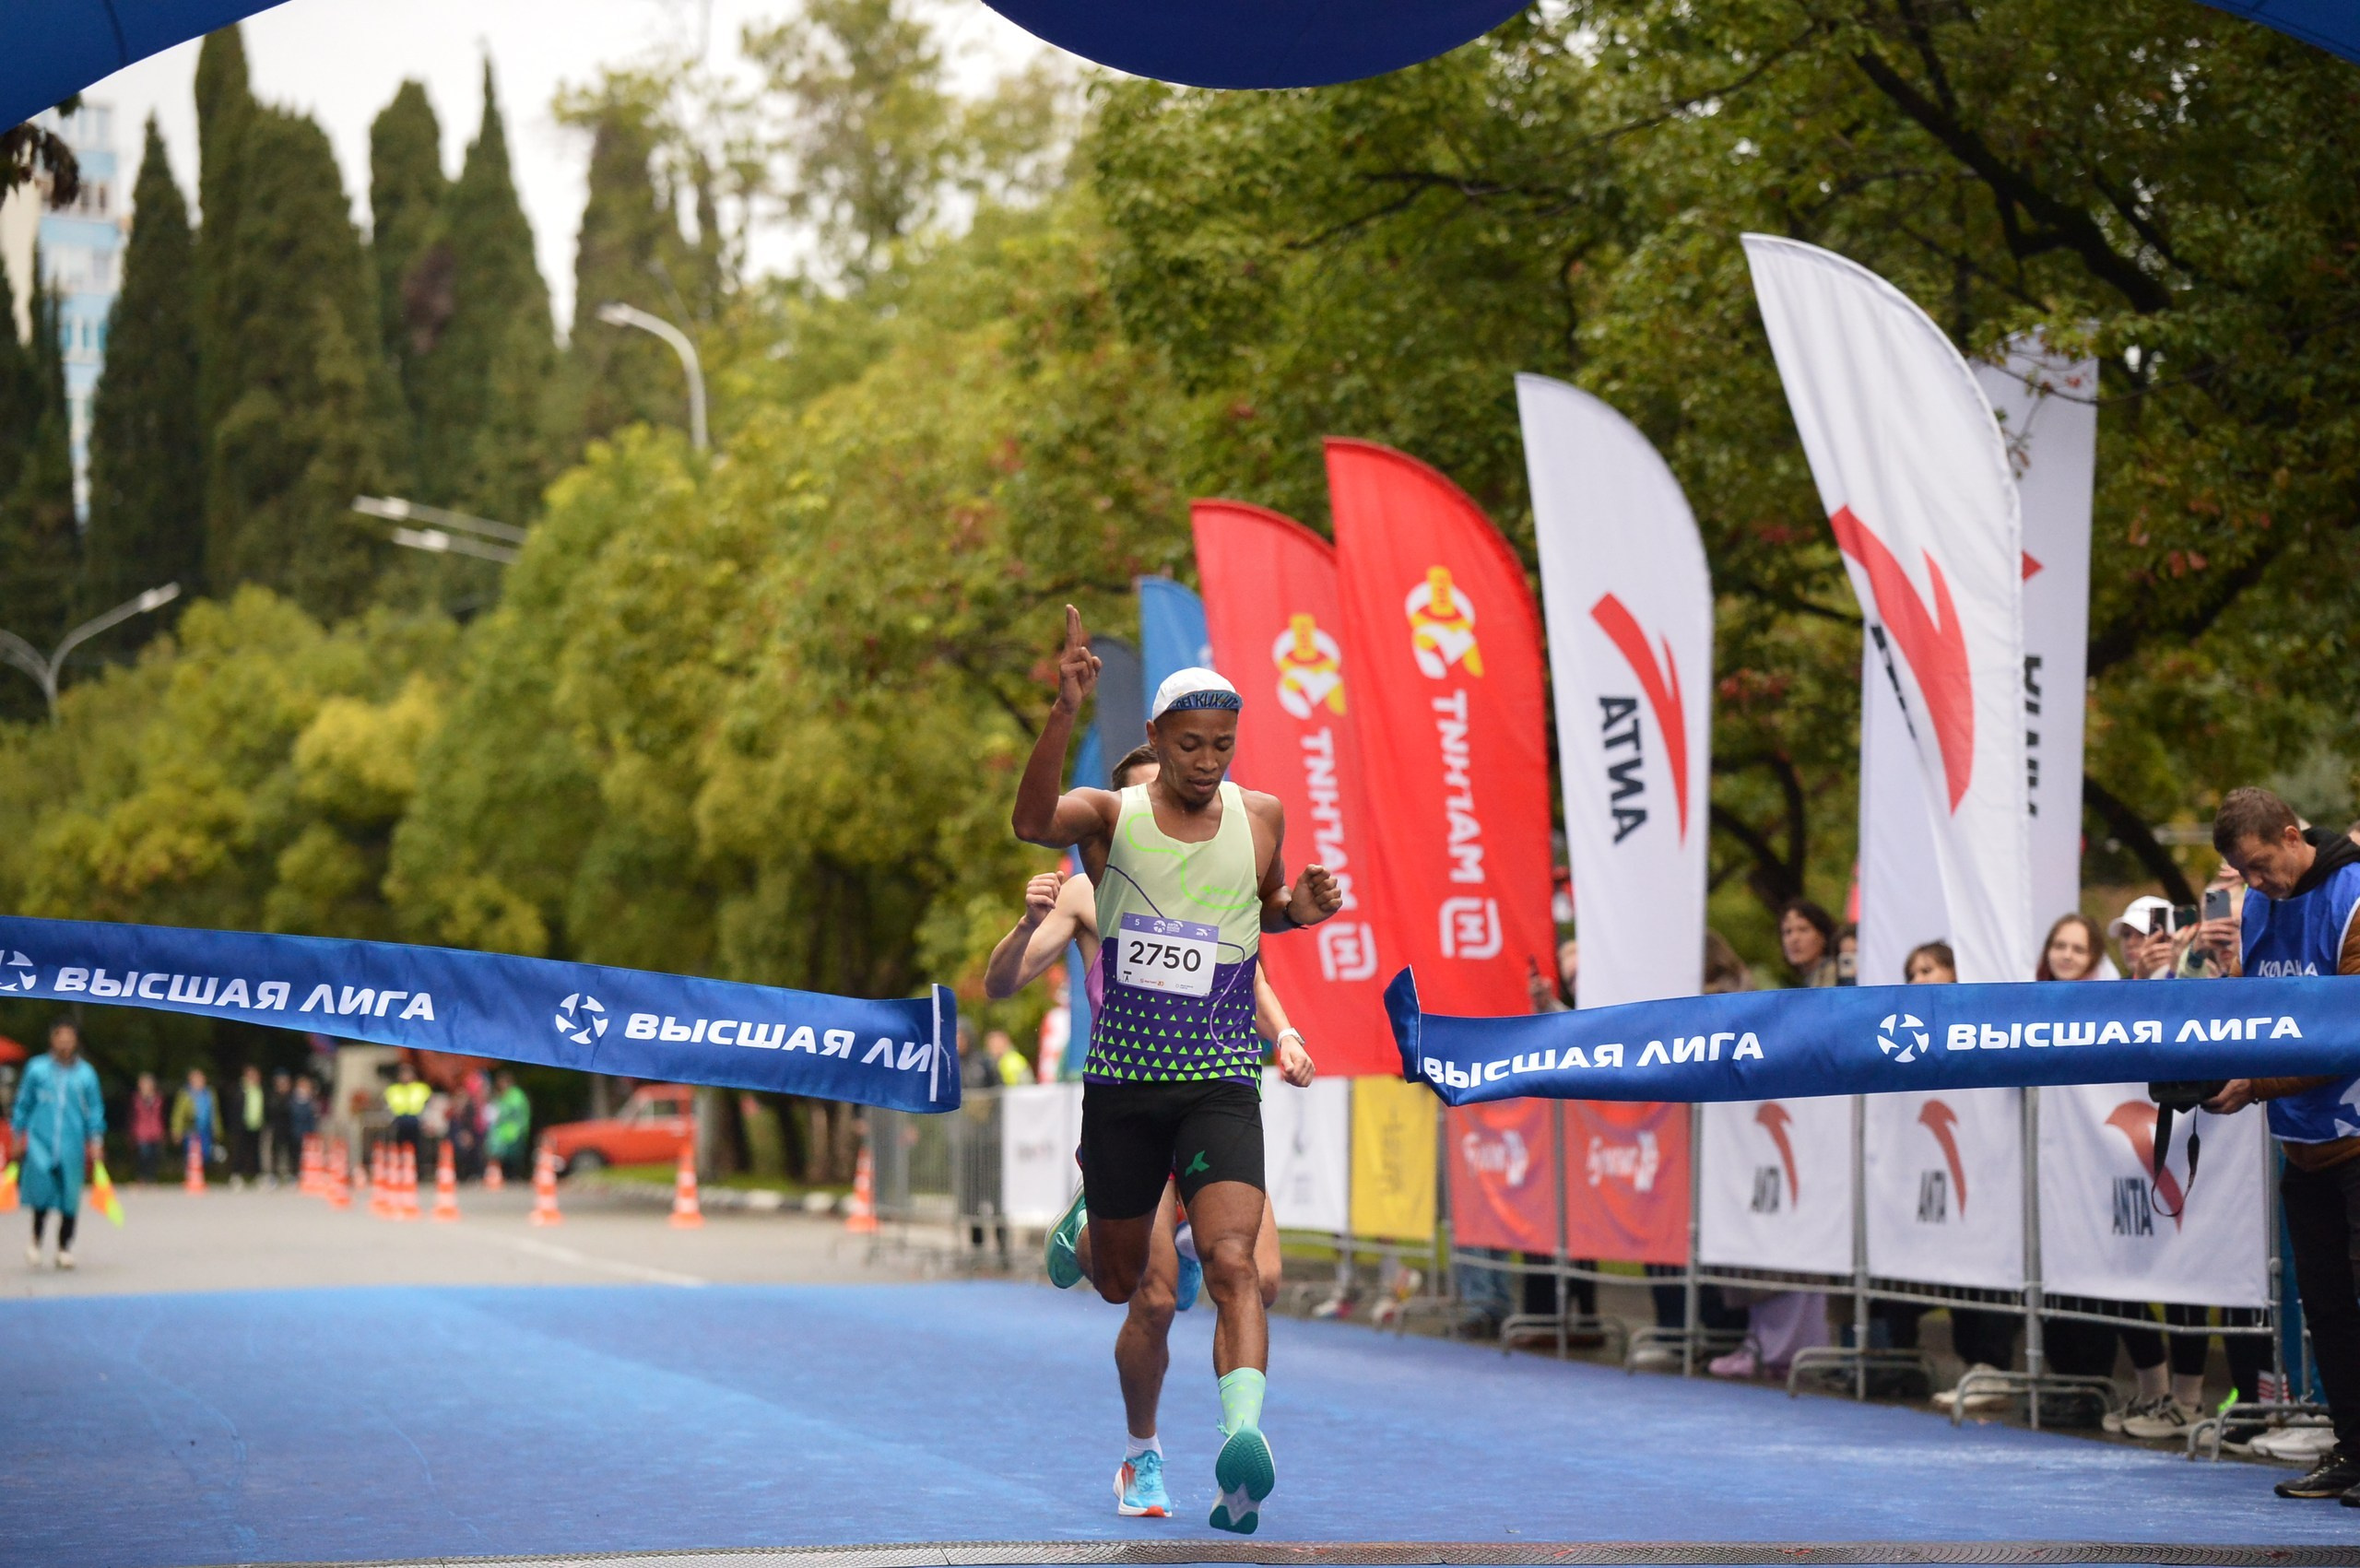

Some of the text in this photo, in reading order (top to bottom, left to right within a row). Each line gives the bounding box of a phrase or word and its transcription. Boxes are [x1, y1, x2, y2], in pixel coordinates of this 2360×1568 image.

[1129, 940, 1201, 972] 2750
[53, 967, 435, 1021] ВЫСШАЯ ЛИГА
[625, 1012, 856, 1059] ВЫСШАЯ
[1946, 1016, 2303, 1051] ВЫСШАЯ ЛИГА
[1424, 1032, 1764, 1089] ВЫСШАЯ ЛИГА
